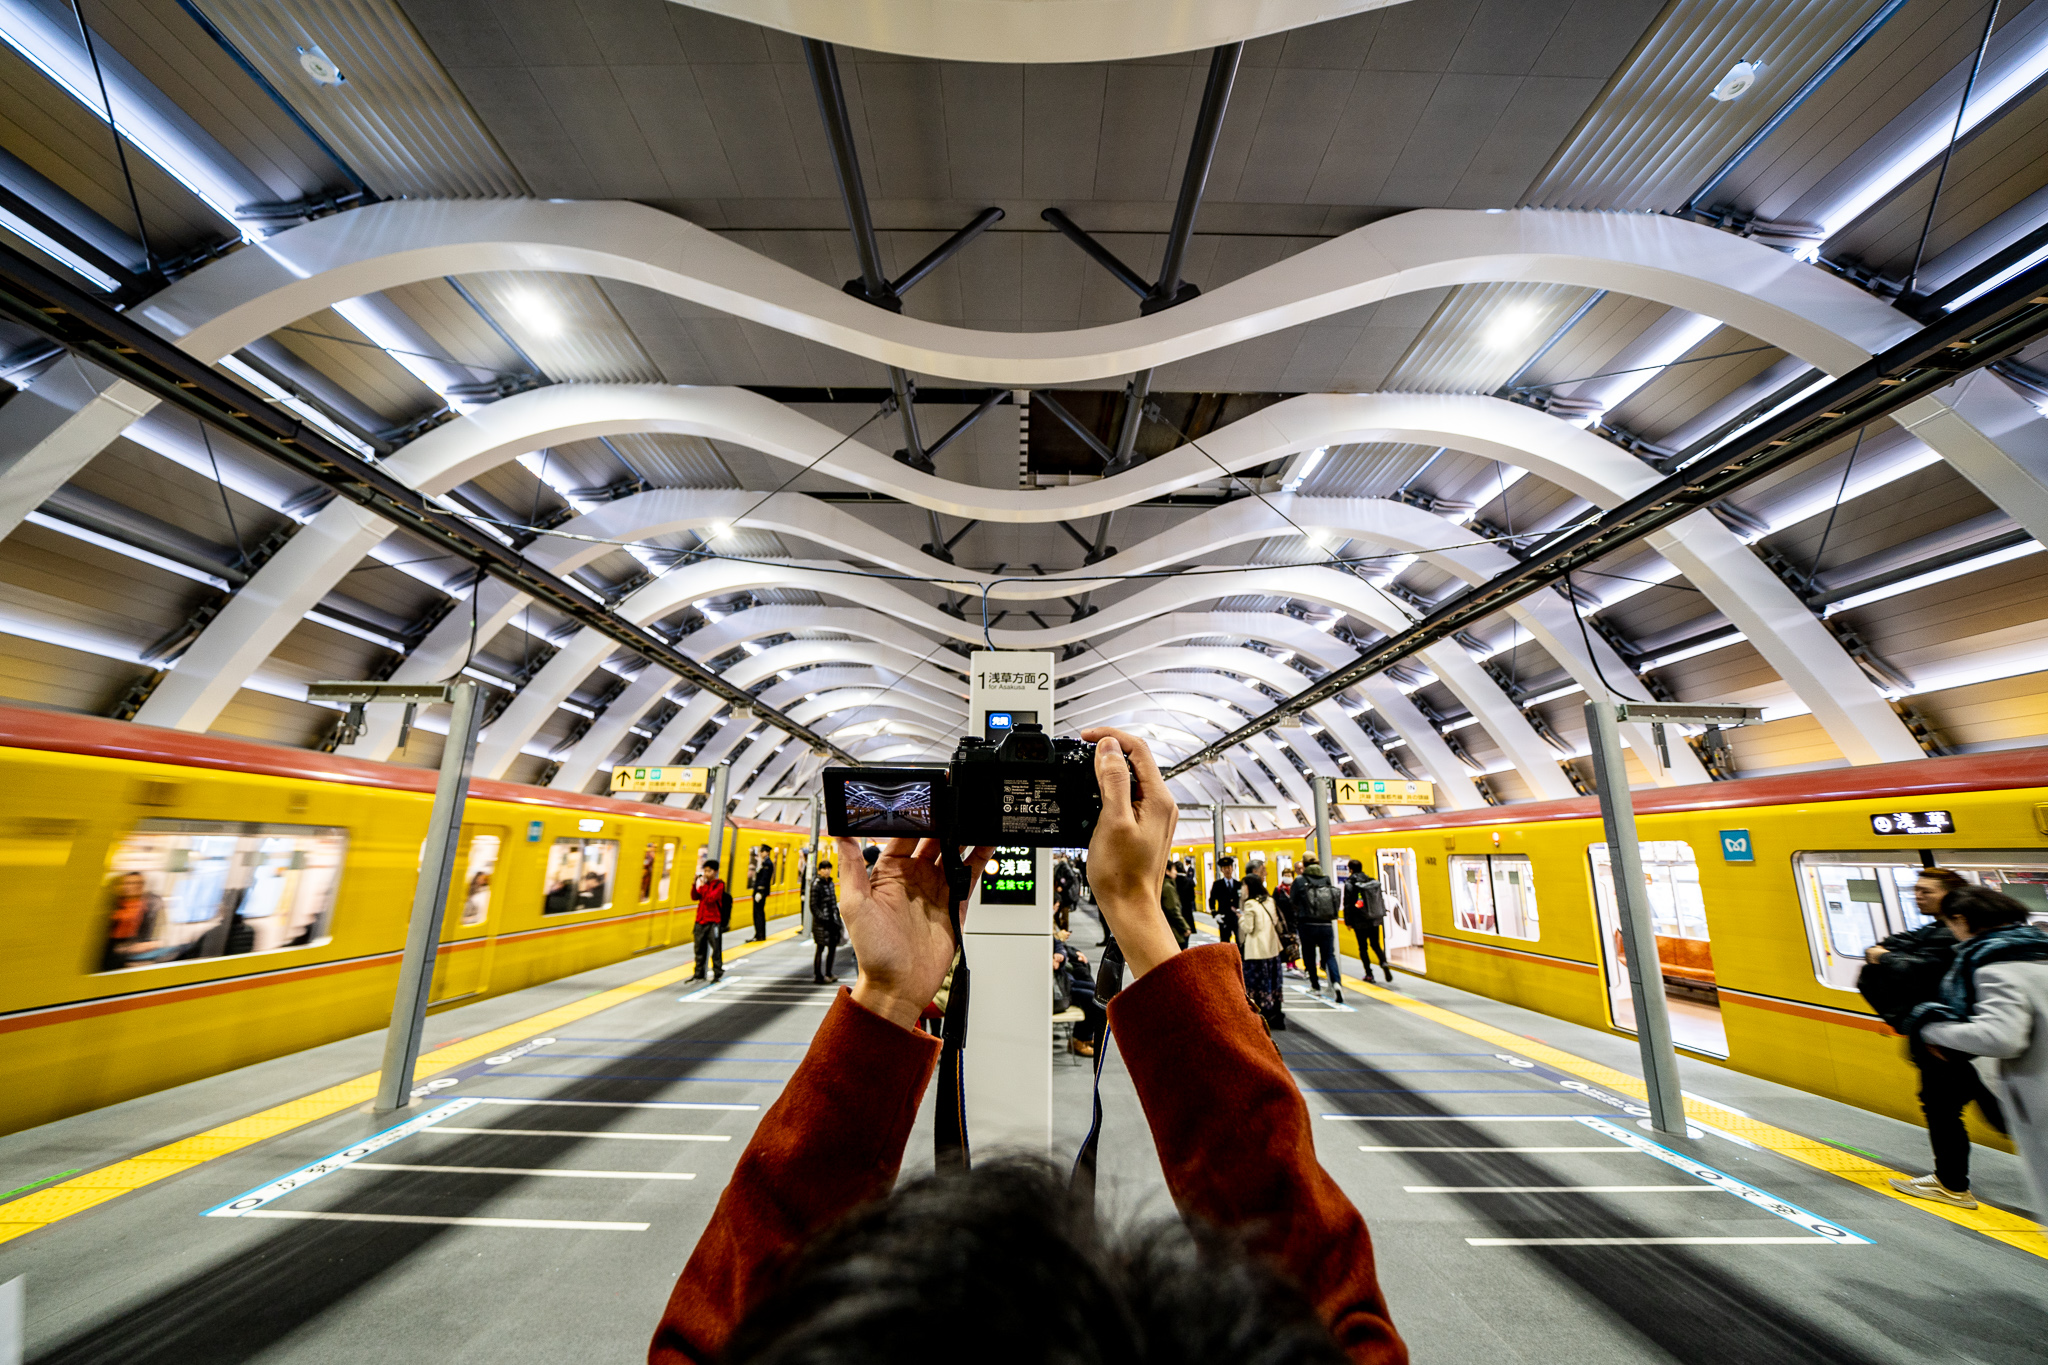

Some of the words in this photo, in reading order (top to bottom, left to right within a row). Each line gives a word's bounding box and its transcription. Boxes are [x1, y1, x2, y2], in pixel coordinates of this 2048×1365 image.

[977, 672, 985, 689] 1
[989, 672, 1036, 684] 浅草方面
[1038, 673, 1049, 690] 2
[1893, 811, 1950, 829] 浅草
[1000, 859, 1032, 876] 浅草
